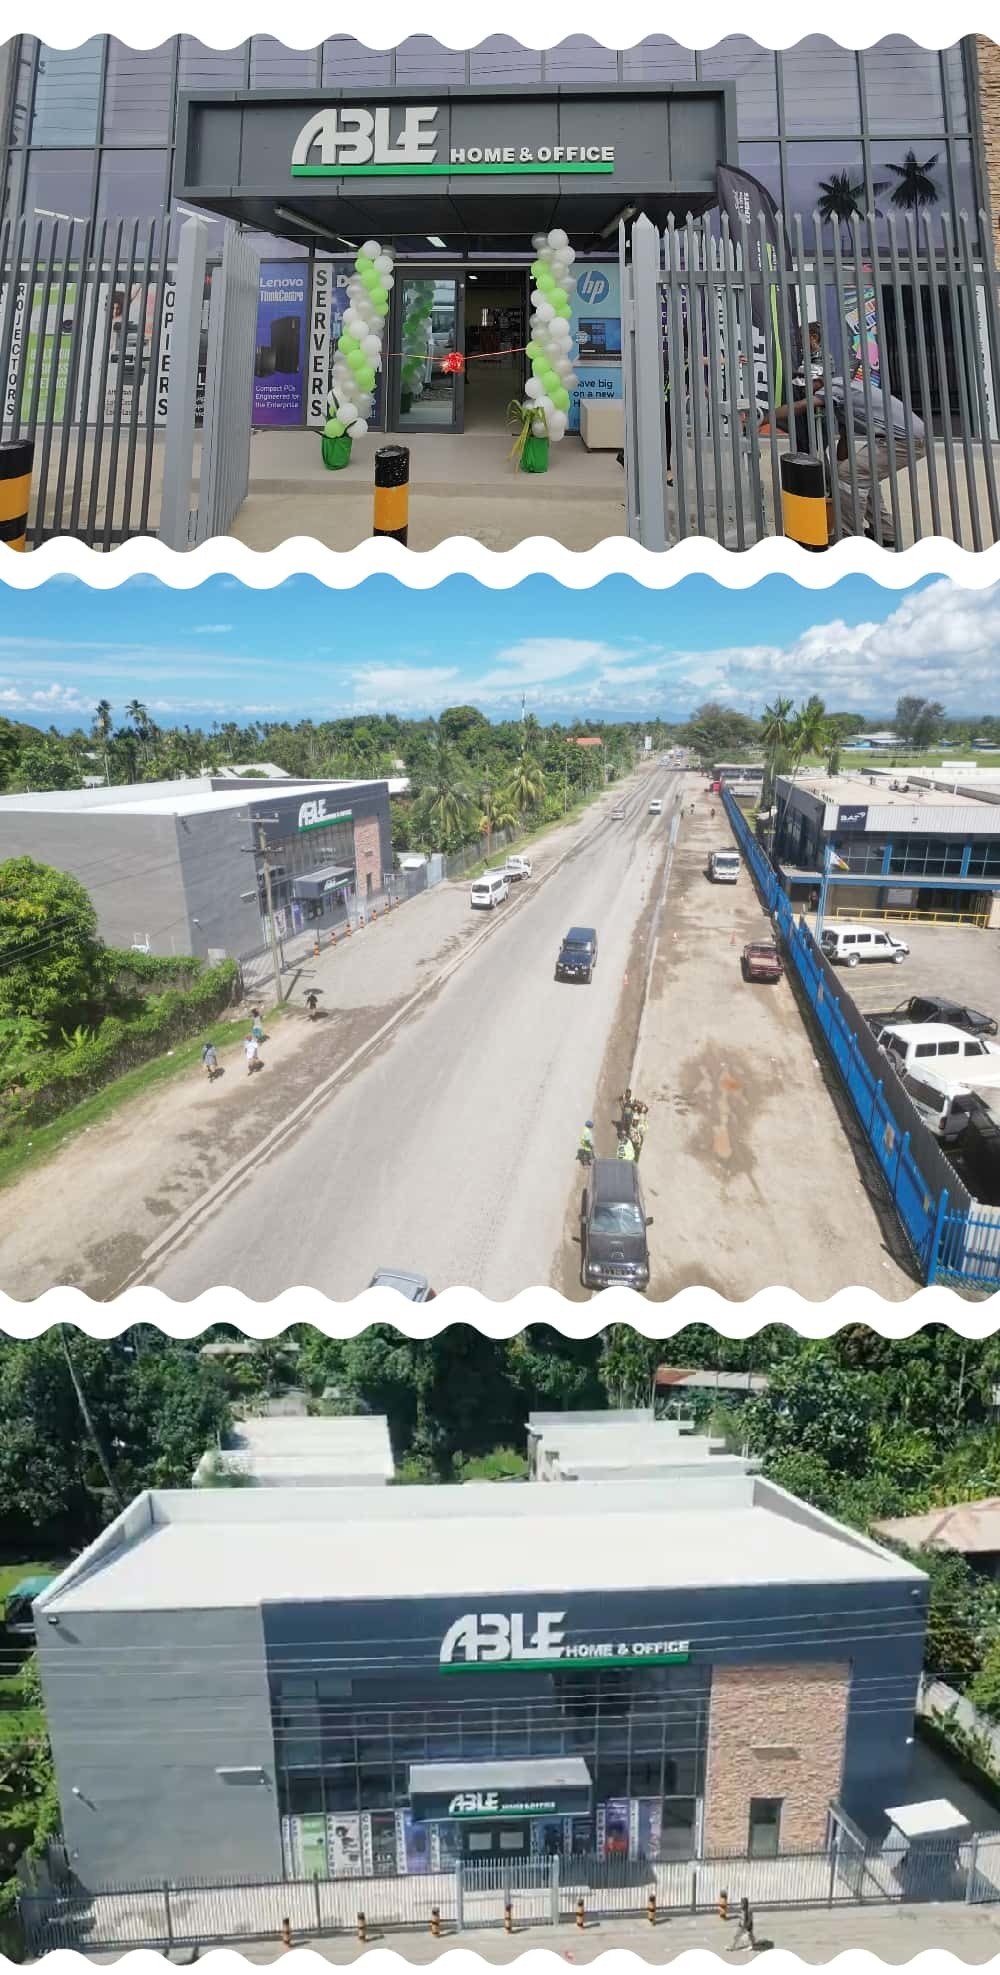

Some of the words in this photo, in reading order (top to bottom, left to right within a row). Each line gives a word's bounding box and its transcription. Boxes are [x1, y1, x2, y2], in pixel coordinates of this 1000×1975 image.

[292, 106, 438, 165] ABLE
[450, 147, 515, 163] HOME
[519, 147, 534, 162] &
[537, 146, 615, 162] OFFICE
[259, 277, 304, 288] Lenovo
[260, 290, 304, 302] ThinkCentre
[311, 269, 327, 417] SERVERS
[6, 285, 26, 416] ROJECTORS
[255, 385, 283, 393] Compact
[577, 380, 596, 388] ave
[599, 379, 613, 390] big
[255, 393, 291, 401] Engineered
[573, 390, 585, 398] on
[596, 390, 615, 398] new
[267, 401, 299, 409] Enterprise
[439, 1611, 566, 1663] ABLE
[565, 1644, 613, 1659] HOME
[617, 1643, 629, 1656] &
[632, 1640, 690, 1655] OFFICE
[448, 1792, 499, 1815] ABLE
